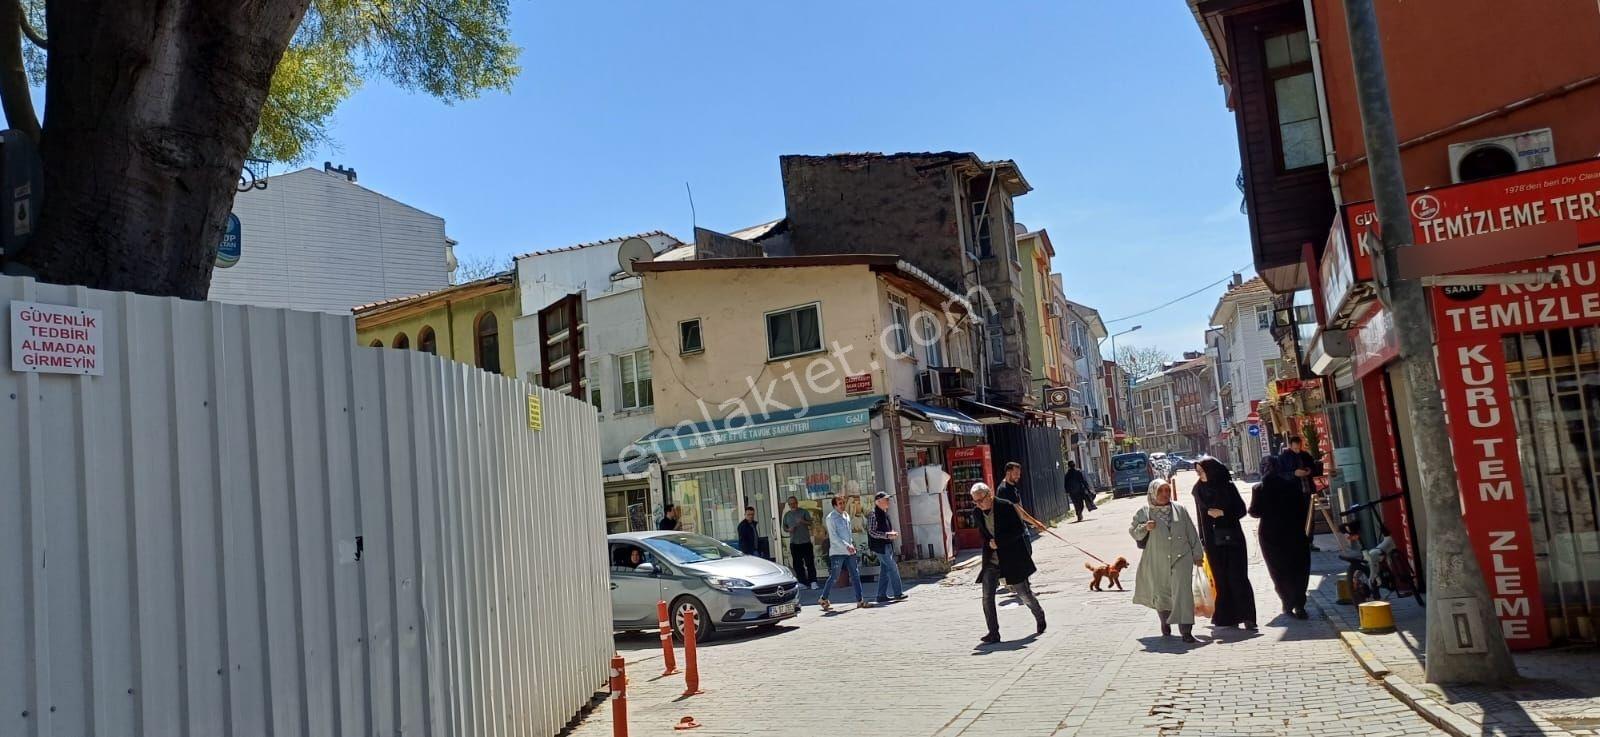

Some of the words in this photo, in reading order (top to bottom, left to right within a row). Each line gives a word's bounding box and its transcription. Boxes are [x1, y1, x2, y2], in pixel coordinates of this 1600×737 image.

[1561, 176, 1577, 185] Dry
[1419, 200, 1547, 244] TEMİZLEME
[1551, 190, 1600, 221] TER
[20, 309, 96, 328] GÜVENLİK
[1446, 293, 1600, 332] TEMİZLE
[28, 325, 89, 341] TEDBİRİ
[22, 340, 96, 356] ALMADAN
[23, 352, 95, 369] GİRMEYİN
[1457, 344, 1501, 428] KURU
[749, 428, 771, 439] TAVUK
